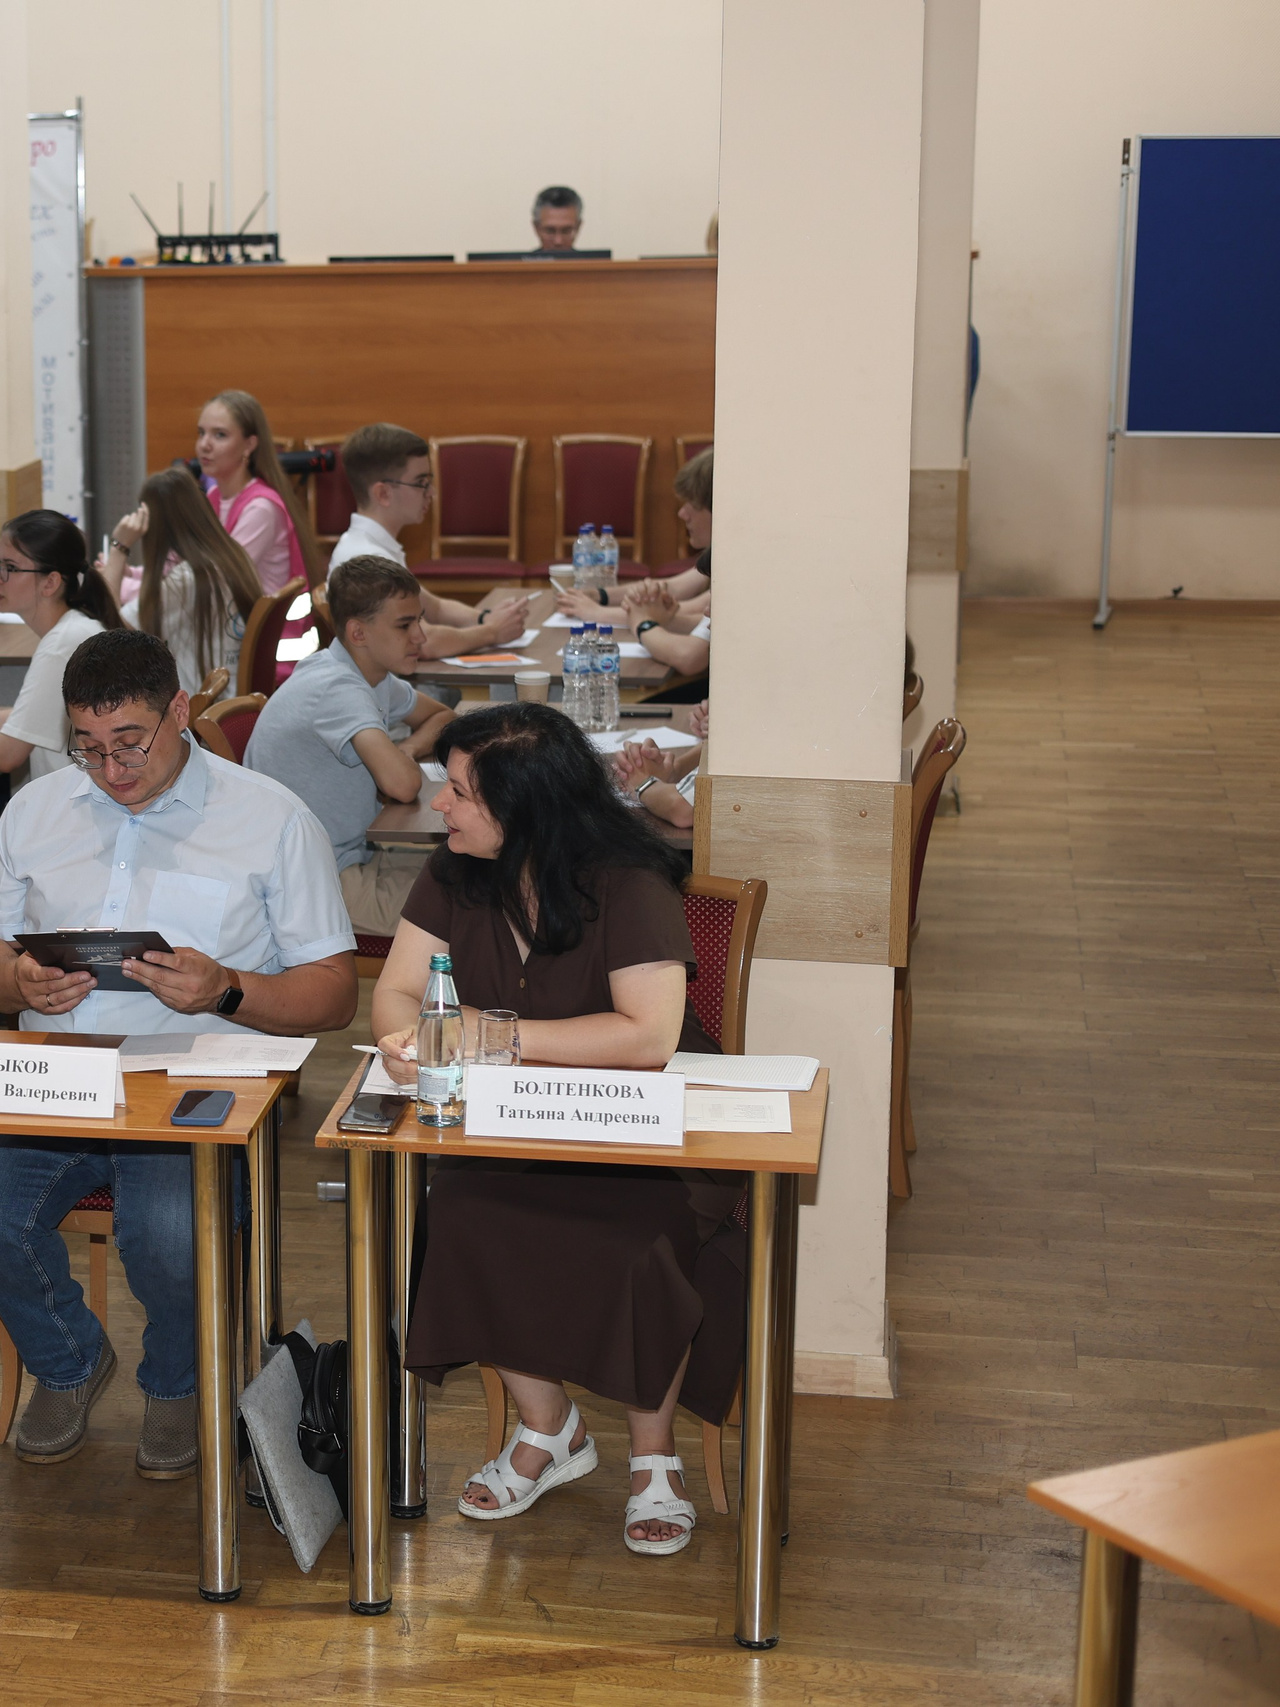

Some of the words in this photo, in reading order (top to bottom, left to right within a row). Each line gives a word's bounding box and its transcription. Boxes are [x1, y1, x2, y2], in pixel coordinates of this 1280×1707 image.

[4, 1083, 98, 1103] Валерьевич
[513, 1080, 644, 1099] БОЛТЕНКОВА
[496, 1104, 565, 1121] Татьяна
[570, 1108, 660, 1126] Андреевна
